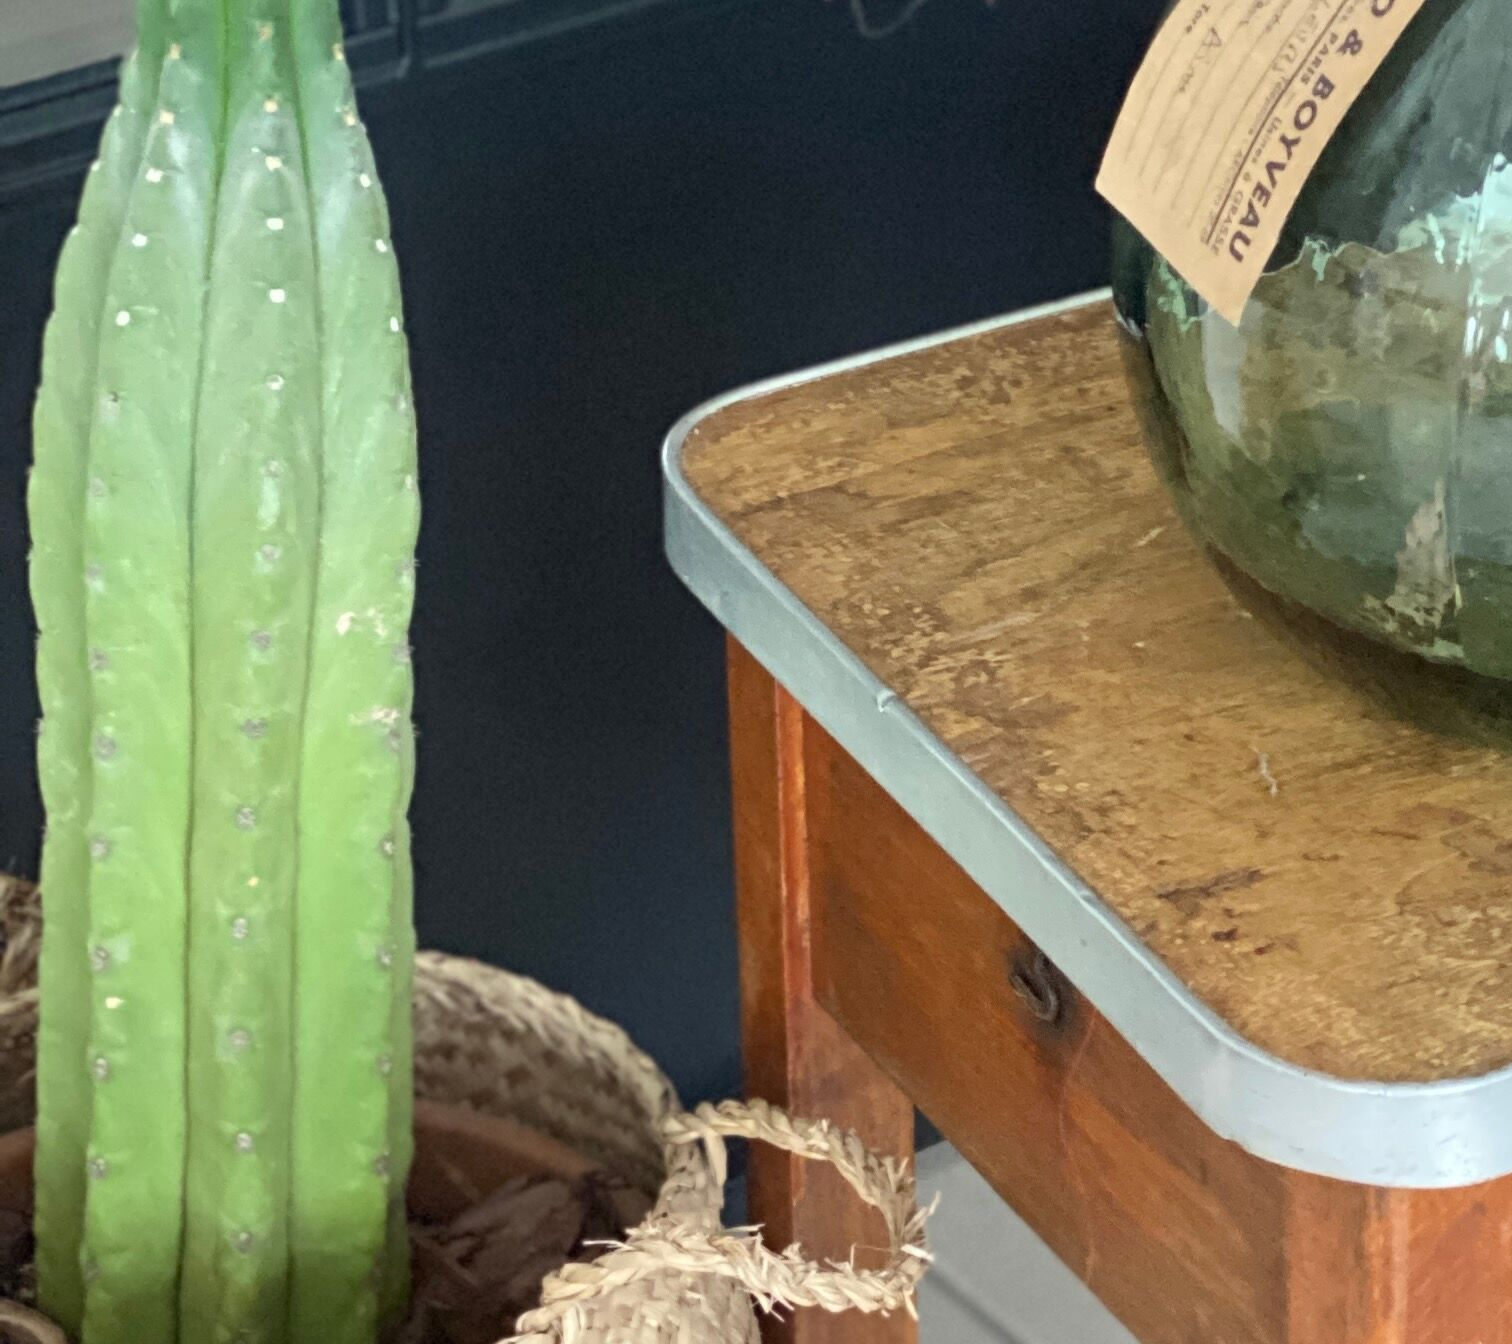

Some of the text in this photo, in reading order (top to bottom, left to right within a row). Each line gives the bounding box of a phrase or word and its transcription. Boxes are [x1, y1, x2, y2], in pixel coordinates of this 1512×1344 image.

[1299, 31, 1339, 85] PARIS
[1335, 27, 1364, 56] &
[1227, 72, 1336, 263] BOYVEAU
